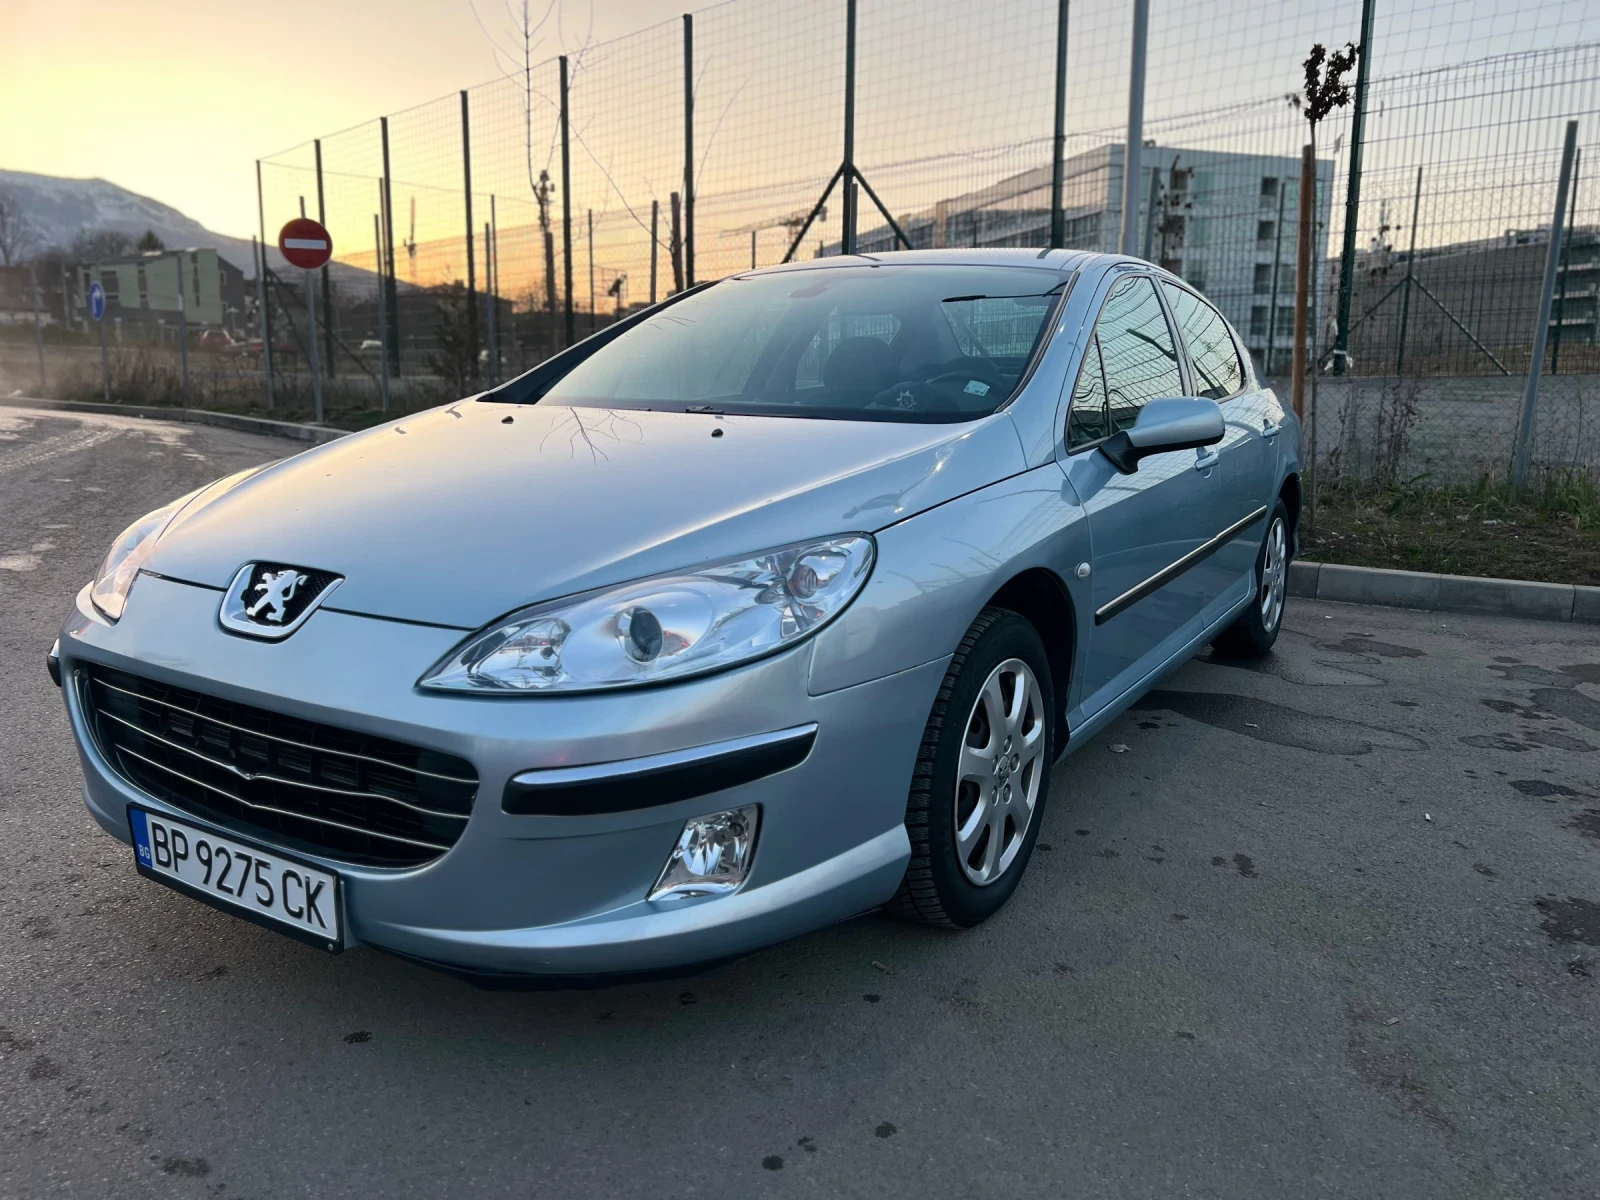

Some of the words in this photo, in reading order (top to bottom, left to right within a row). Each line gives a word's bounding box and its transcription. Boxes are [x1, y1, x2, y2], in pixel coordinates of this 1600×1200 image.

[138, 844, 150, 859] BG
[152, 821, 189, 872] BP
[196, 840, 274, 907] 9275
[281, 868, 327, 929] CK
